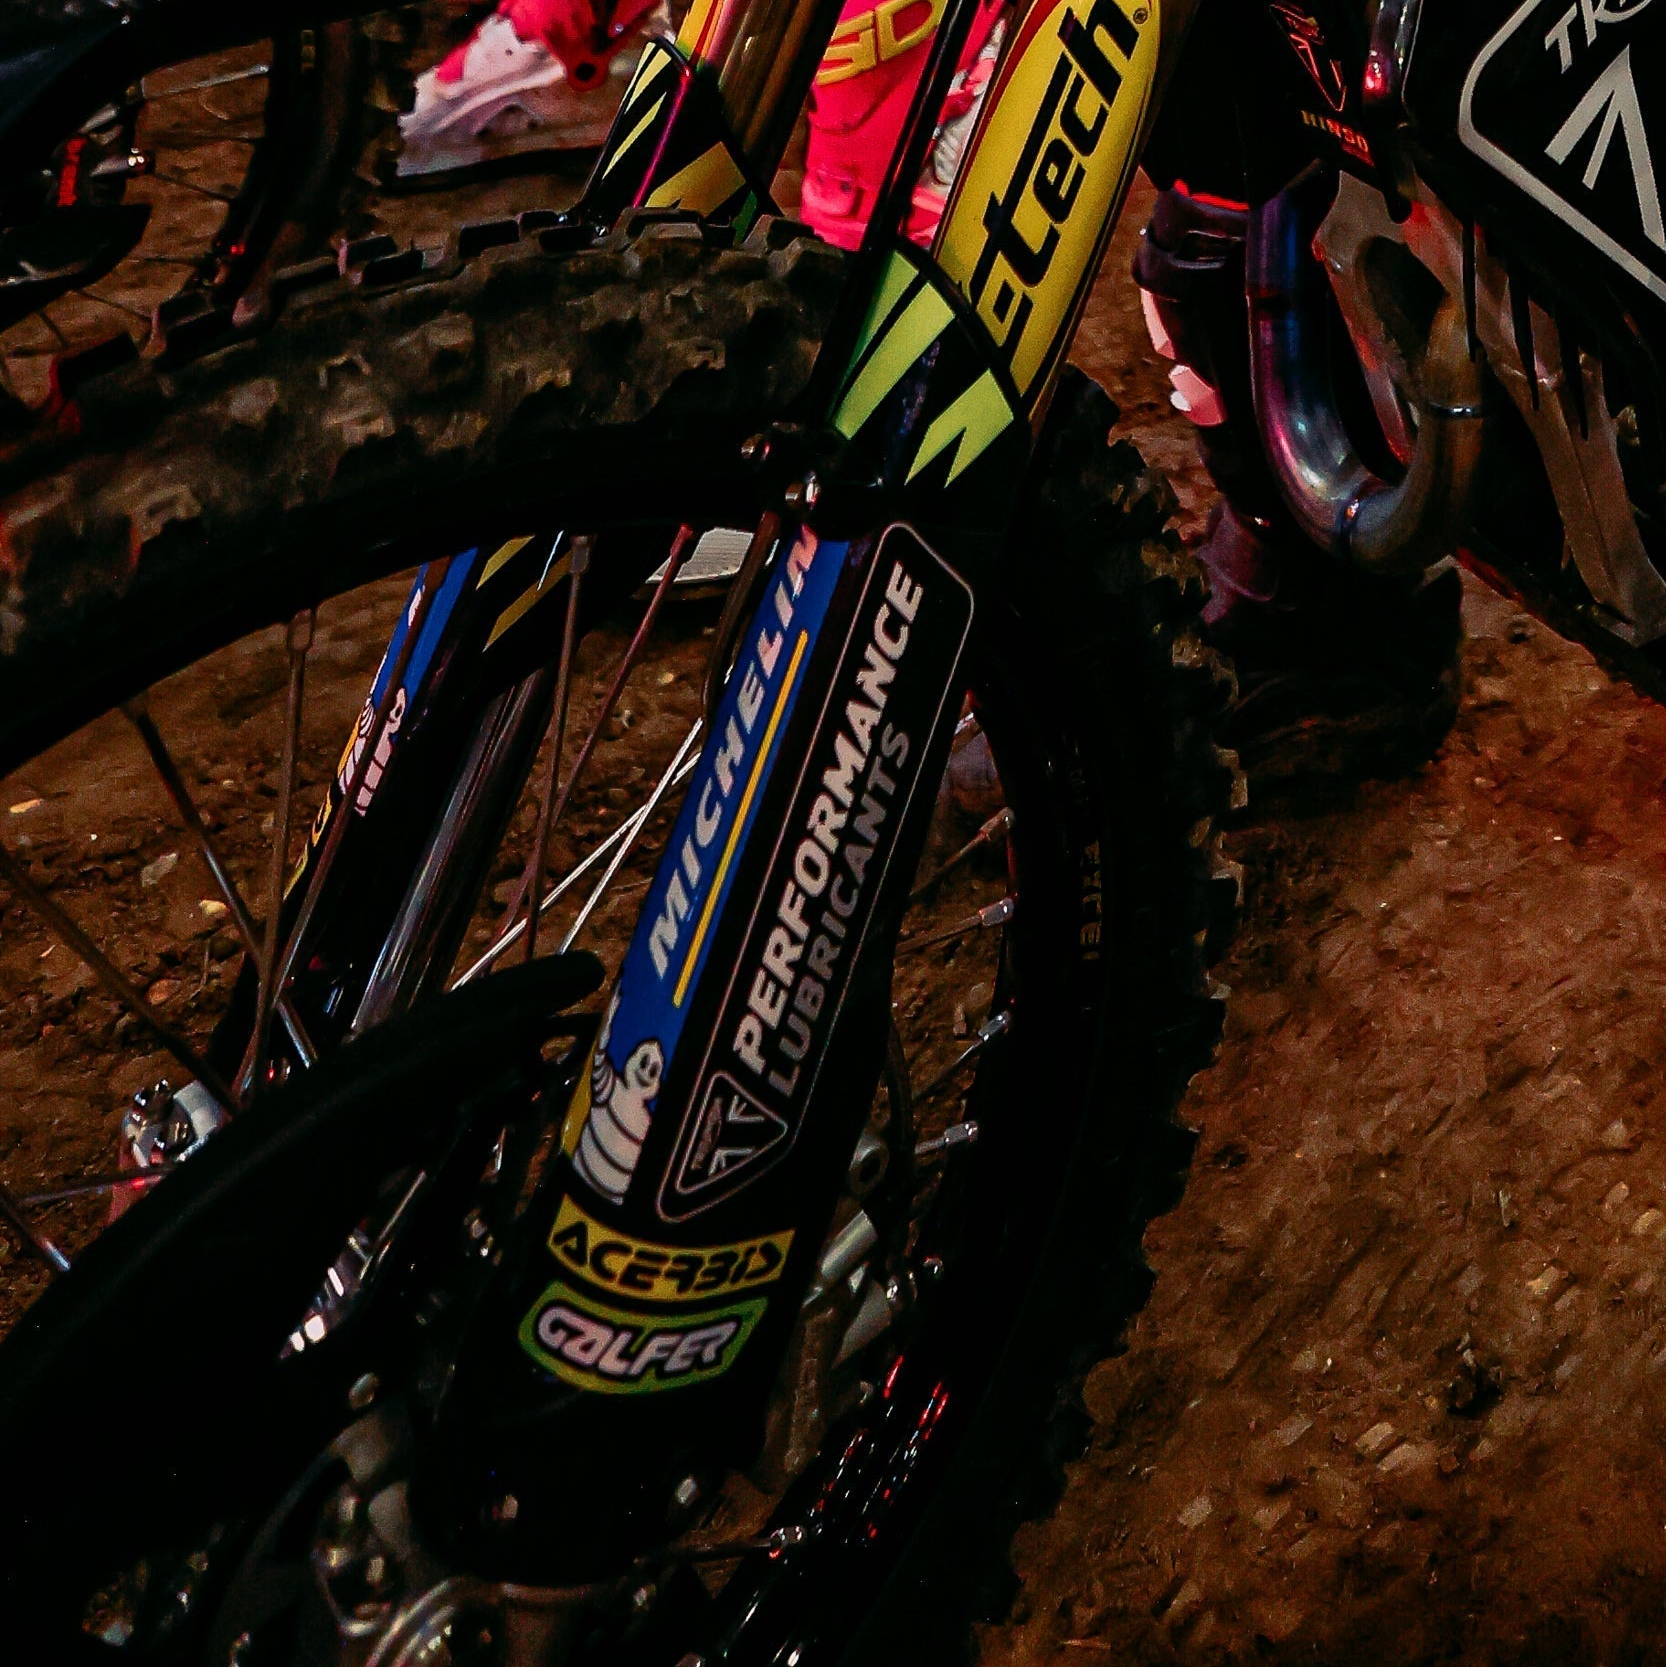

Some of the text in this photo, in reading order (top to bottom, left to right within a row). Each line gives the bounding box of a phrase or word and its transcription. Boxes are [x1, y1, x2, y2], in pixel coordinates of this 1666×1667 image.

[649, 523, 820, 980] MICHELIN
[732, 560, 924, 1075] PERFORMANCE
[768, 722, 911, 1098] LUBRICANTS
[536, 1305, 740, 1377] GALFER
[552, 1220, 785, 1296] ACERBIS
